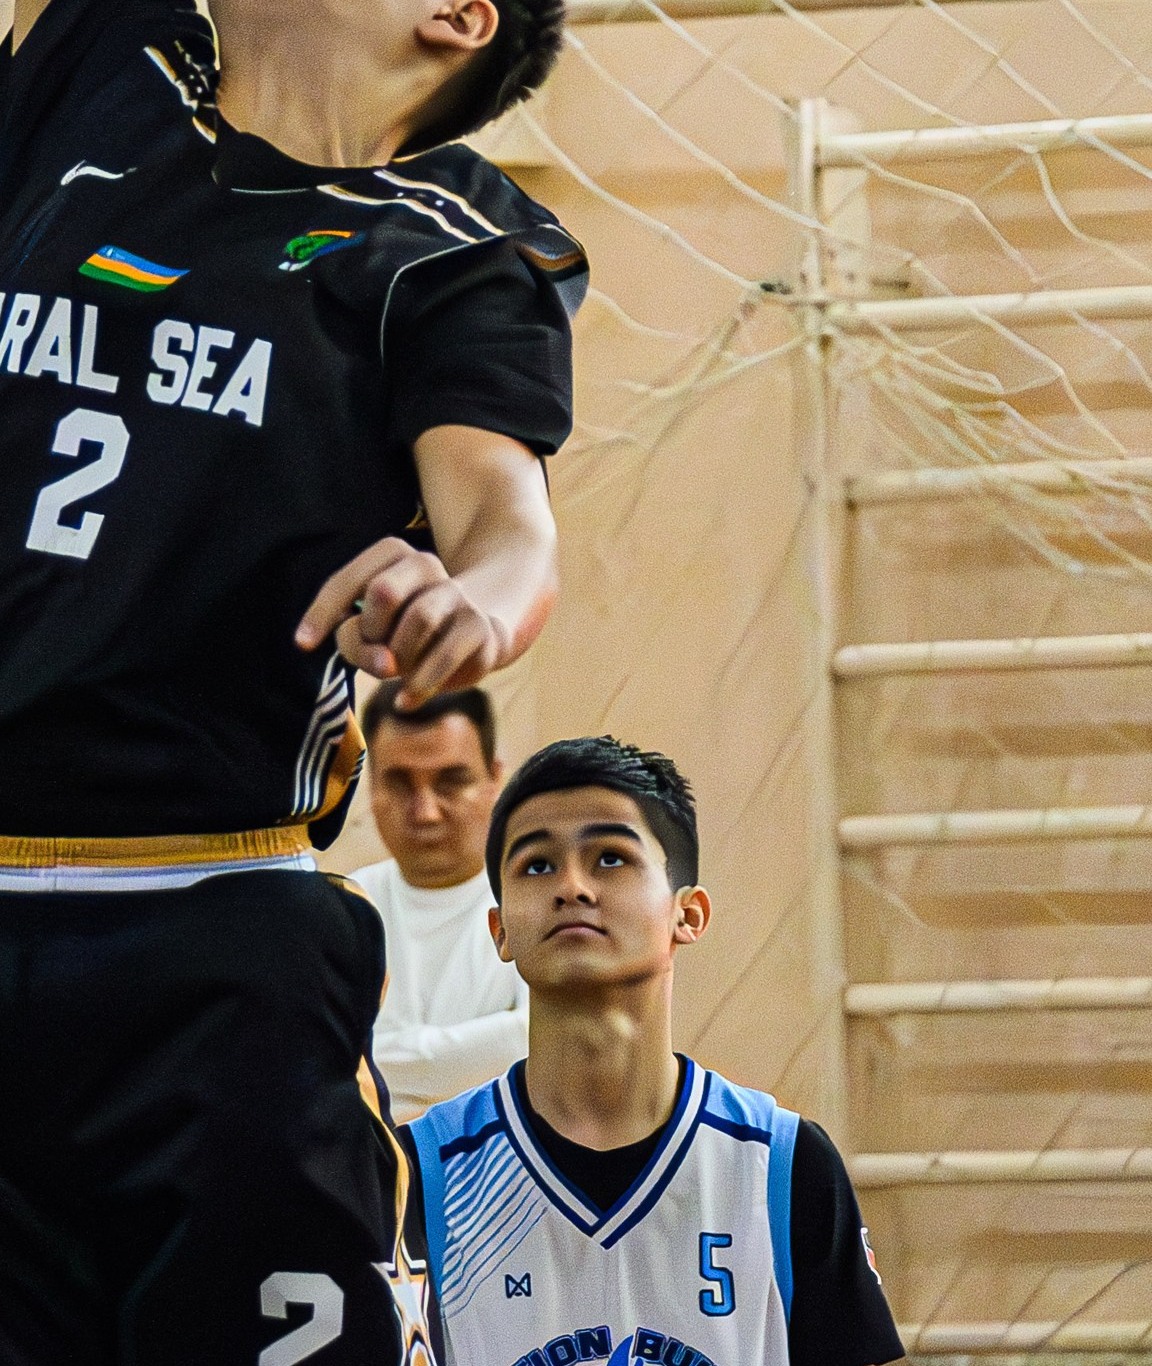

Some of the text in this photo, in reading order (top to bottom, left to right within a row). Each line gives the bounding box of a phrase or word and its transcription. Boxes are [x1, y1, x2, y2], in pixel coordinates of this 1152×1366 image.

[146, 318, 273, 427] SEA
[25, 407, 130, 559] 2
[698, 1231, 736, 1317] 5
